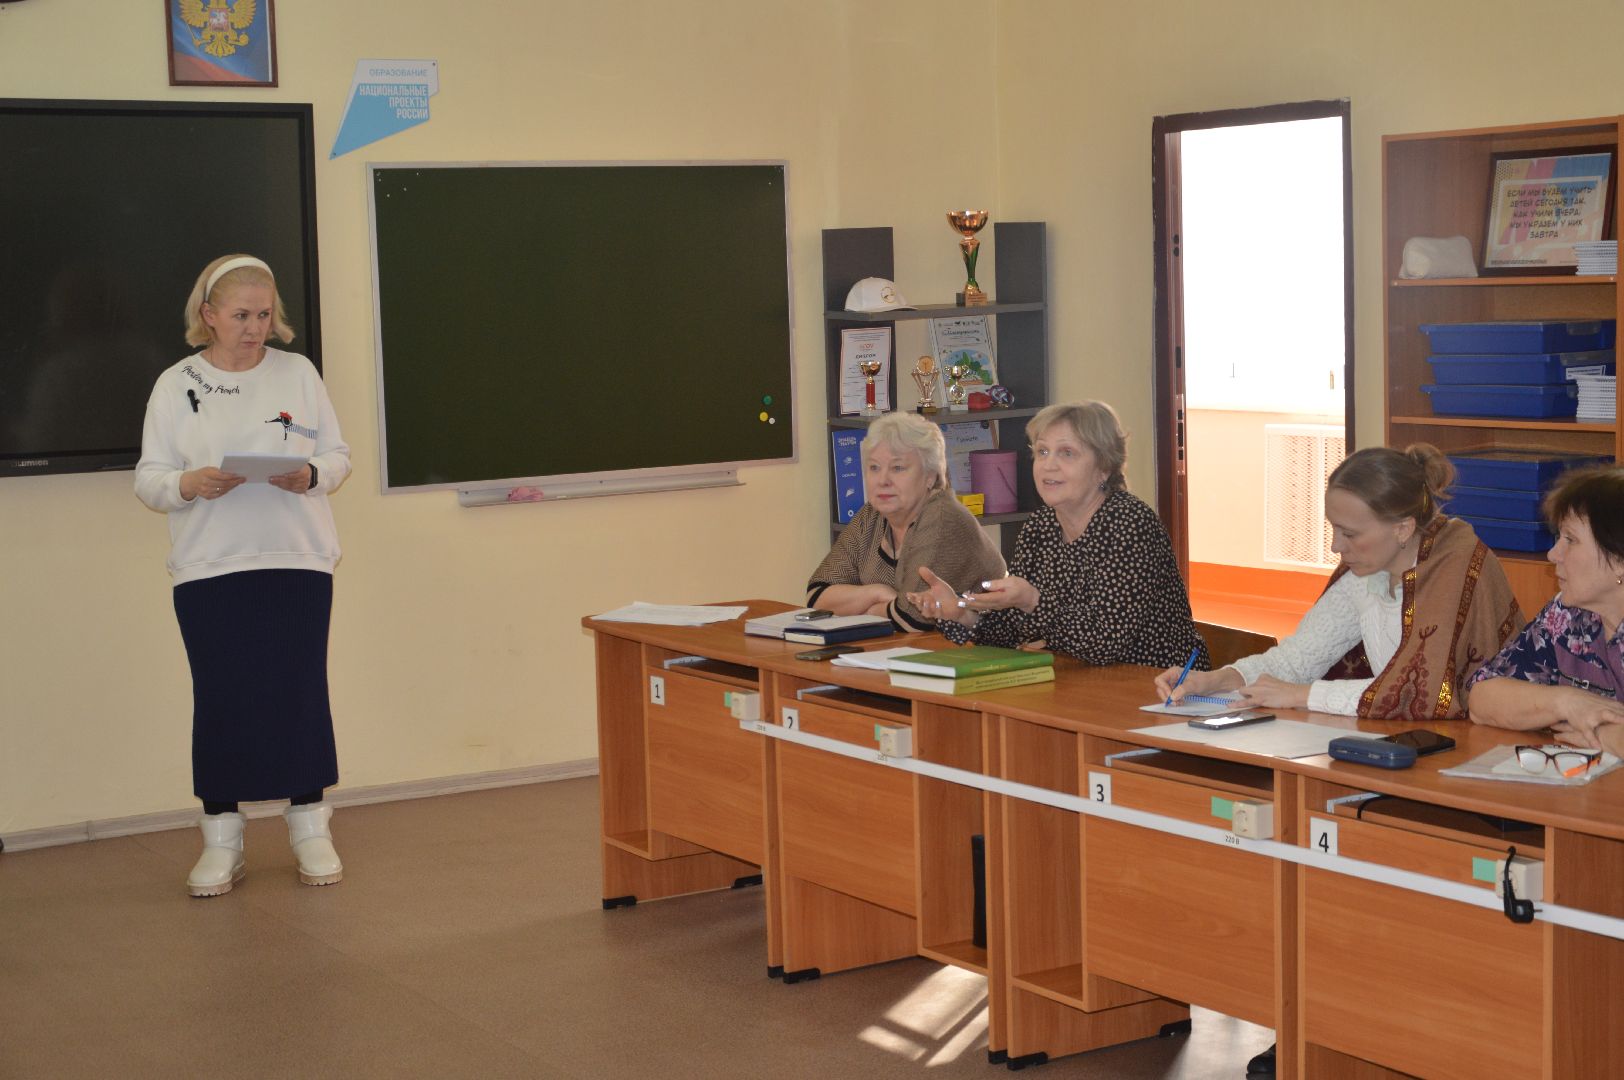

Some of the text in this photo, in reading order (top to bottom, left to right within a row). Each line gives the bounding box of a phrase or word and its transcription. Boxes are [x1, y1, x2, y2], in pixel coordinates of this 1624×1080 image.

[368, 68, 428, 77] ОБРАЗОВАНИЕ
[360, 84, 427, 96] НАЦИОНАЛЬНЫЕ
[389, 96, 428, 108] ПРОЕКТЫ
[396, 108, 428, 119] РОССИИ
[1542, 188, 1568, 196] БУДЕМ
[1569, 186, 1592, 194] УЧИТЬ
[1510, 200, 1532, 208] ДЕТЕЙ
[1535, 198, 1568, 206] СЕГОДНЯ
[1513, 210, 1528, 218] КАК
[1531, 209, 1553, 217] УЧИЛИ
[1510, 220, 1522, 228] МЫ
[1524, 220, 1558, 228] УКРАДЕМ
[1568, 218, 1583, 226] НИХ
[1530, 230, 1559, 238] ЗАВТРА
[203, 383, 214, 394] my
[214, 385, 240, 395] French
[654, 684, 660, 698] 1
[786, 716, 793, 729] 2
[1096, 784, 1104, 802] 3
[1225, 834, 1235, 844] 220
[1318, 832, 1330, 852] 4
